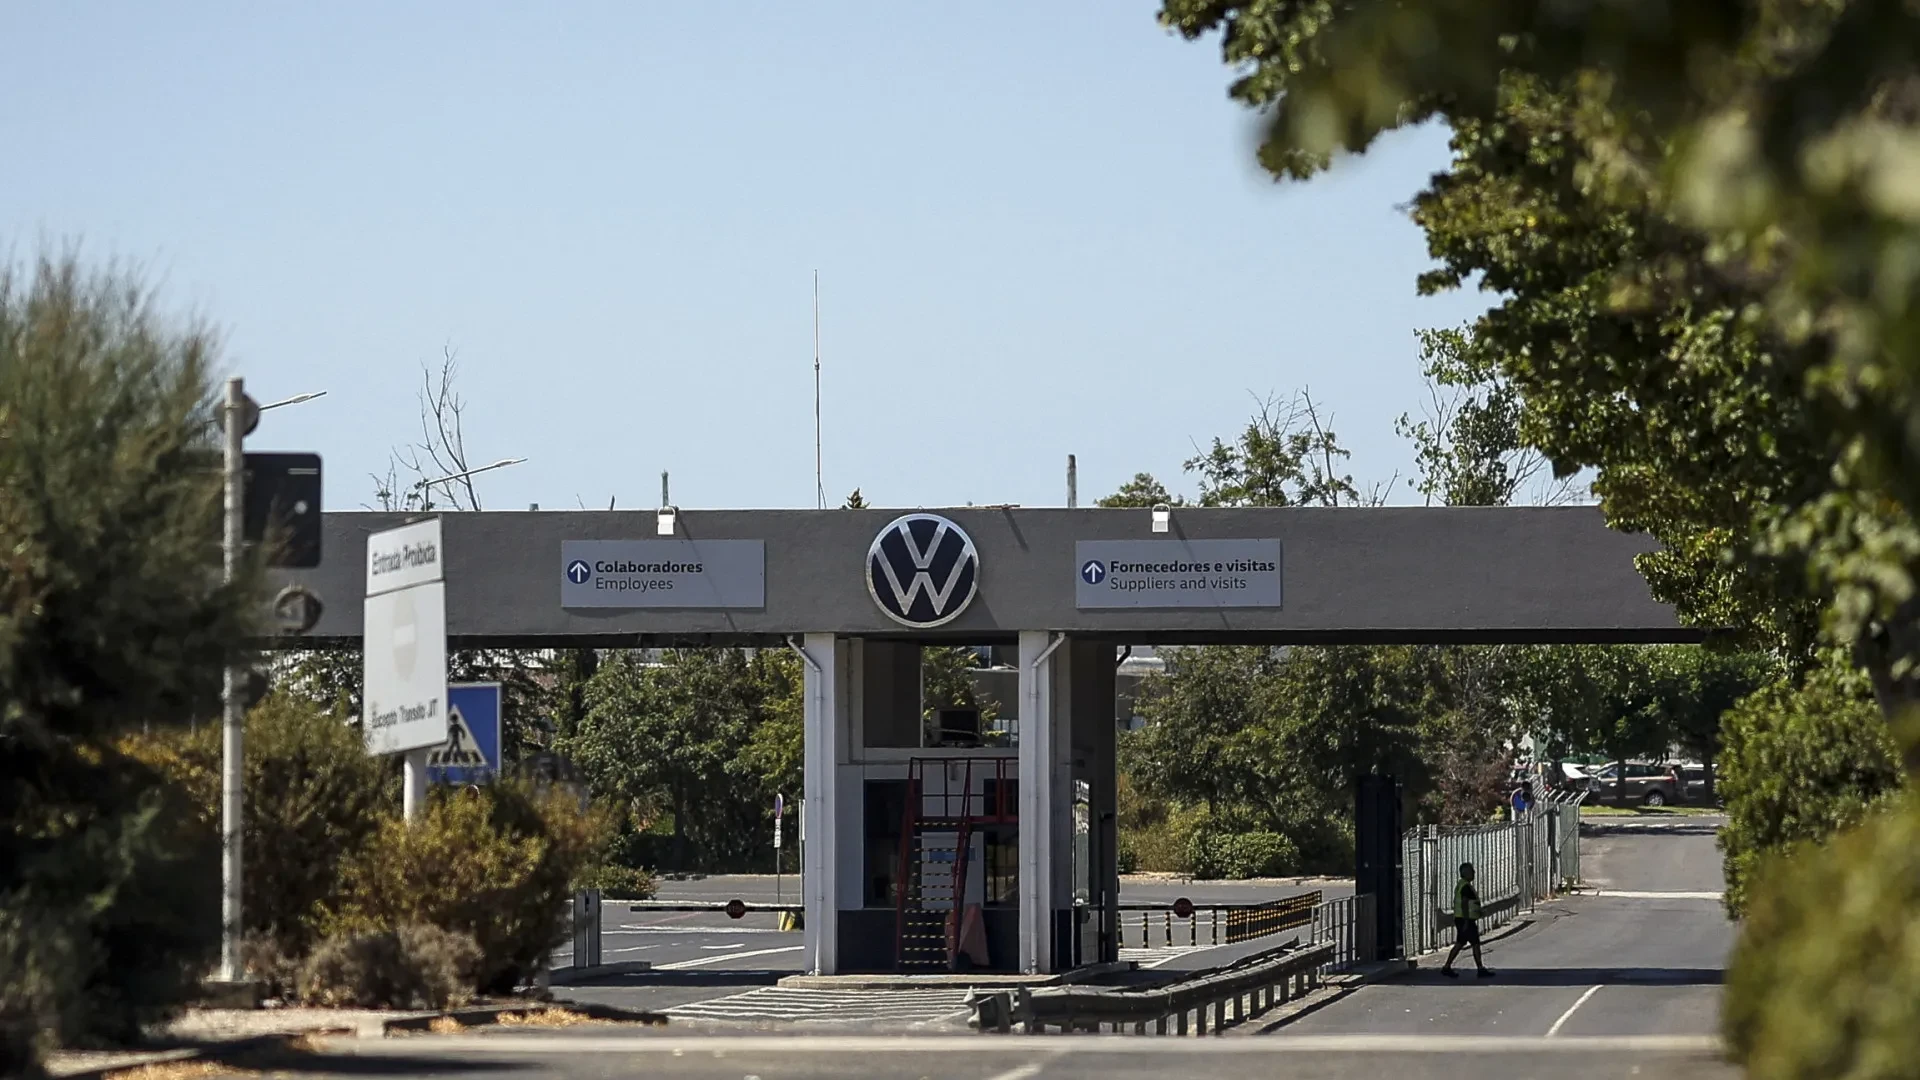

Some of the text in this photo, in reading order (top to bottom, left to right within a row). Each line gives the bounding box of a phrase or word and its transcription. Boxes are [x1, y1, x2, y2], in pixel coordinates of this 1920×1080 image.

[595, 561, 703, 573] Colaboradores
[1110, 559, 1276, 573] Fornecedores e visitas
[595, 577, 674, 593] Employees
[1110, 576, 1247, 592] Suppliers and visits
